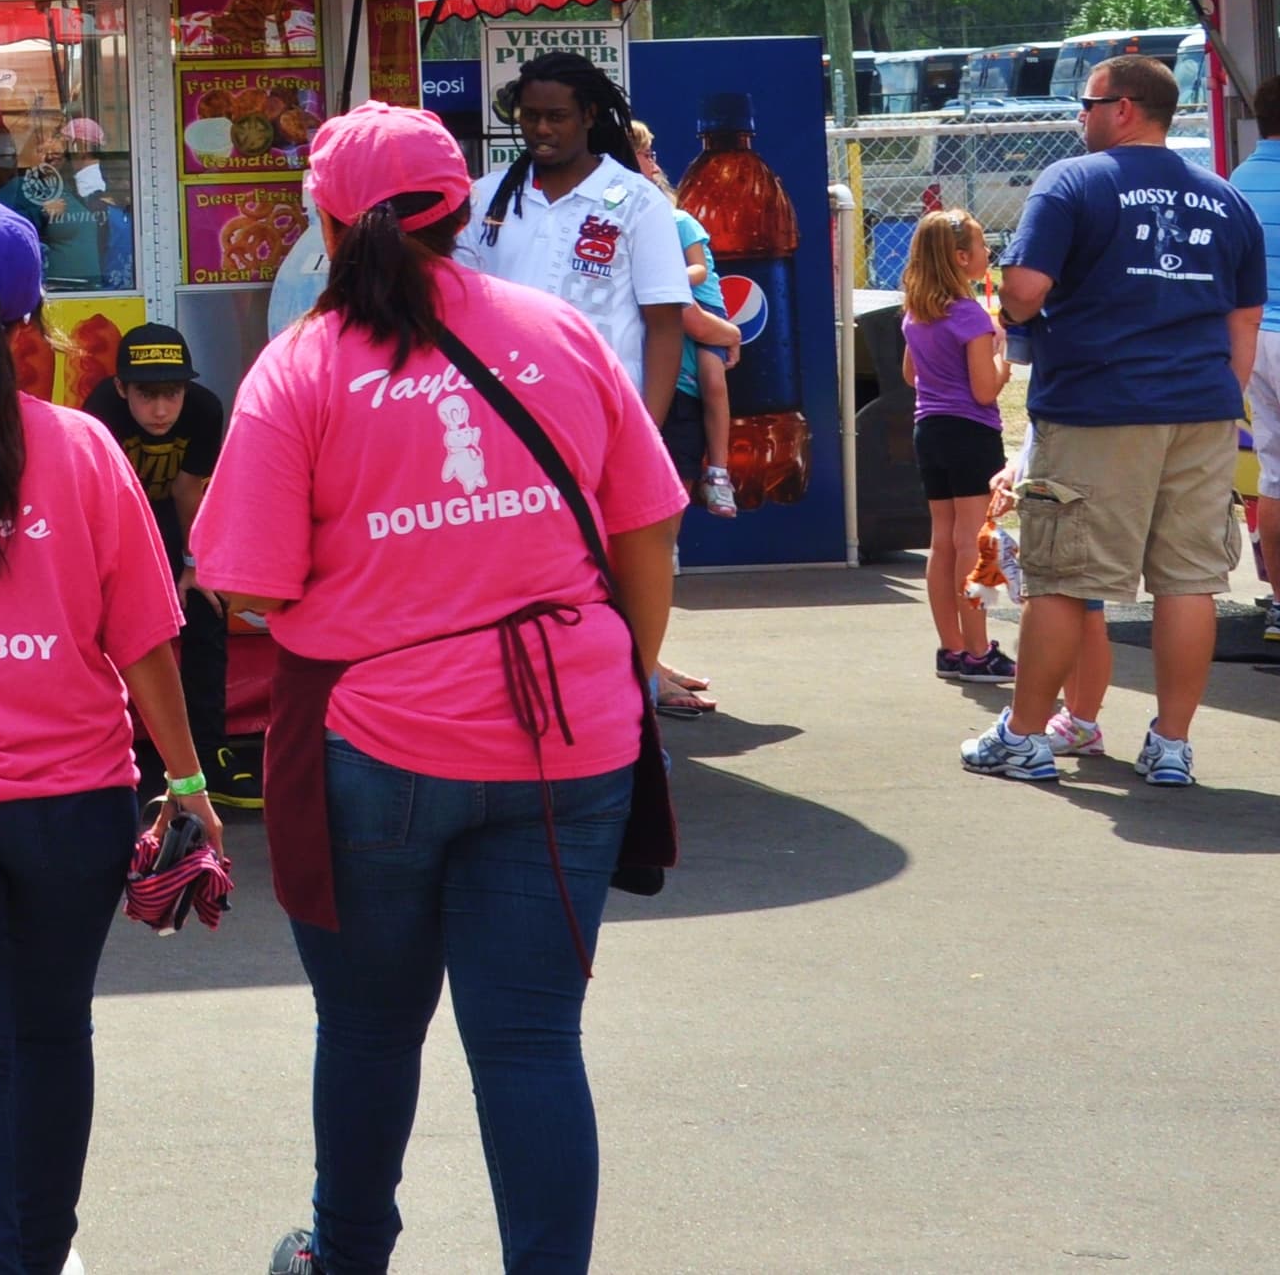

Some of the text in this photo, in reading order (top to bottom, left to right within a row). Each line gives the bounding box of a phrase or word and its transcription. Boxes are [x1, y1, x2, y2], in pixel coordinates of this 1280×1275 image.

[505, 30, 608, 46] VEGGIE
[495, 46, 618, 64] PLER
[254, 187, 302, 205] Frie
[1119, 188, 1228, 218] MOSSY OAK
[1188, 227, 1213, 245] 86
[194, 268, 252, 283] Onion
[348, 350, 545, 409] Tayl's
[366, 484, 561, 540] DOUGHBOY
